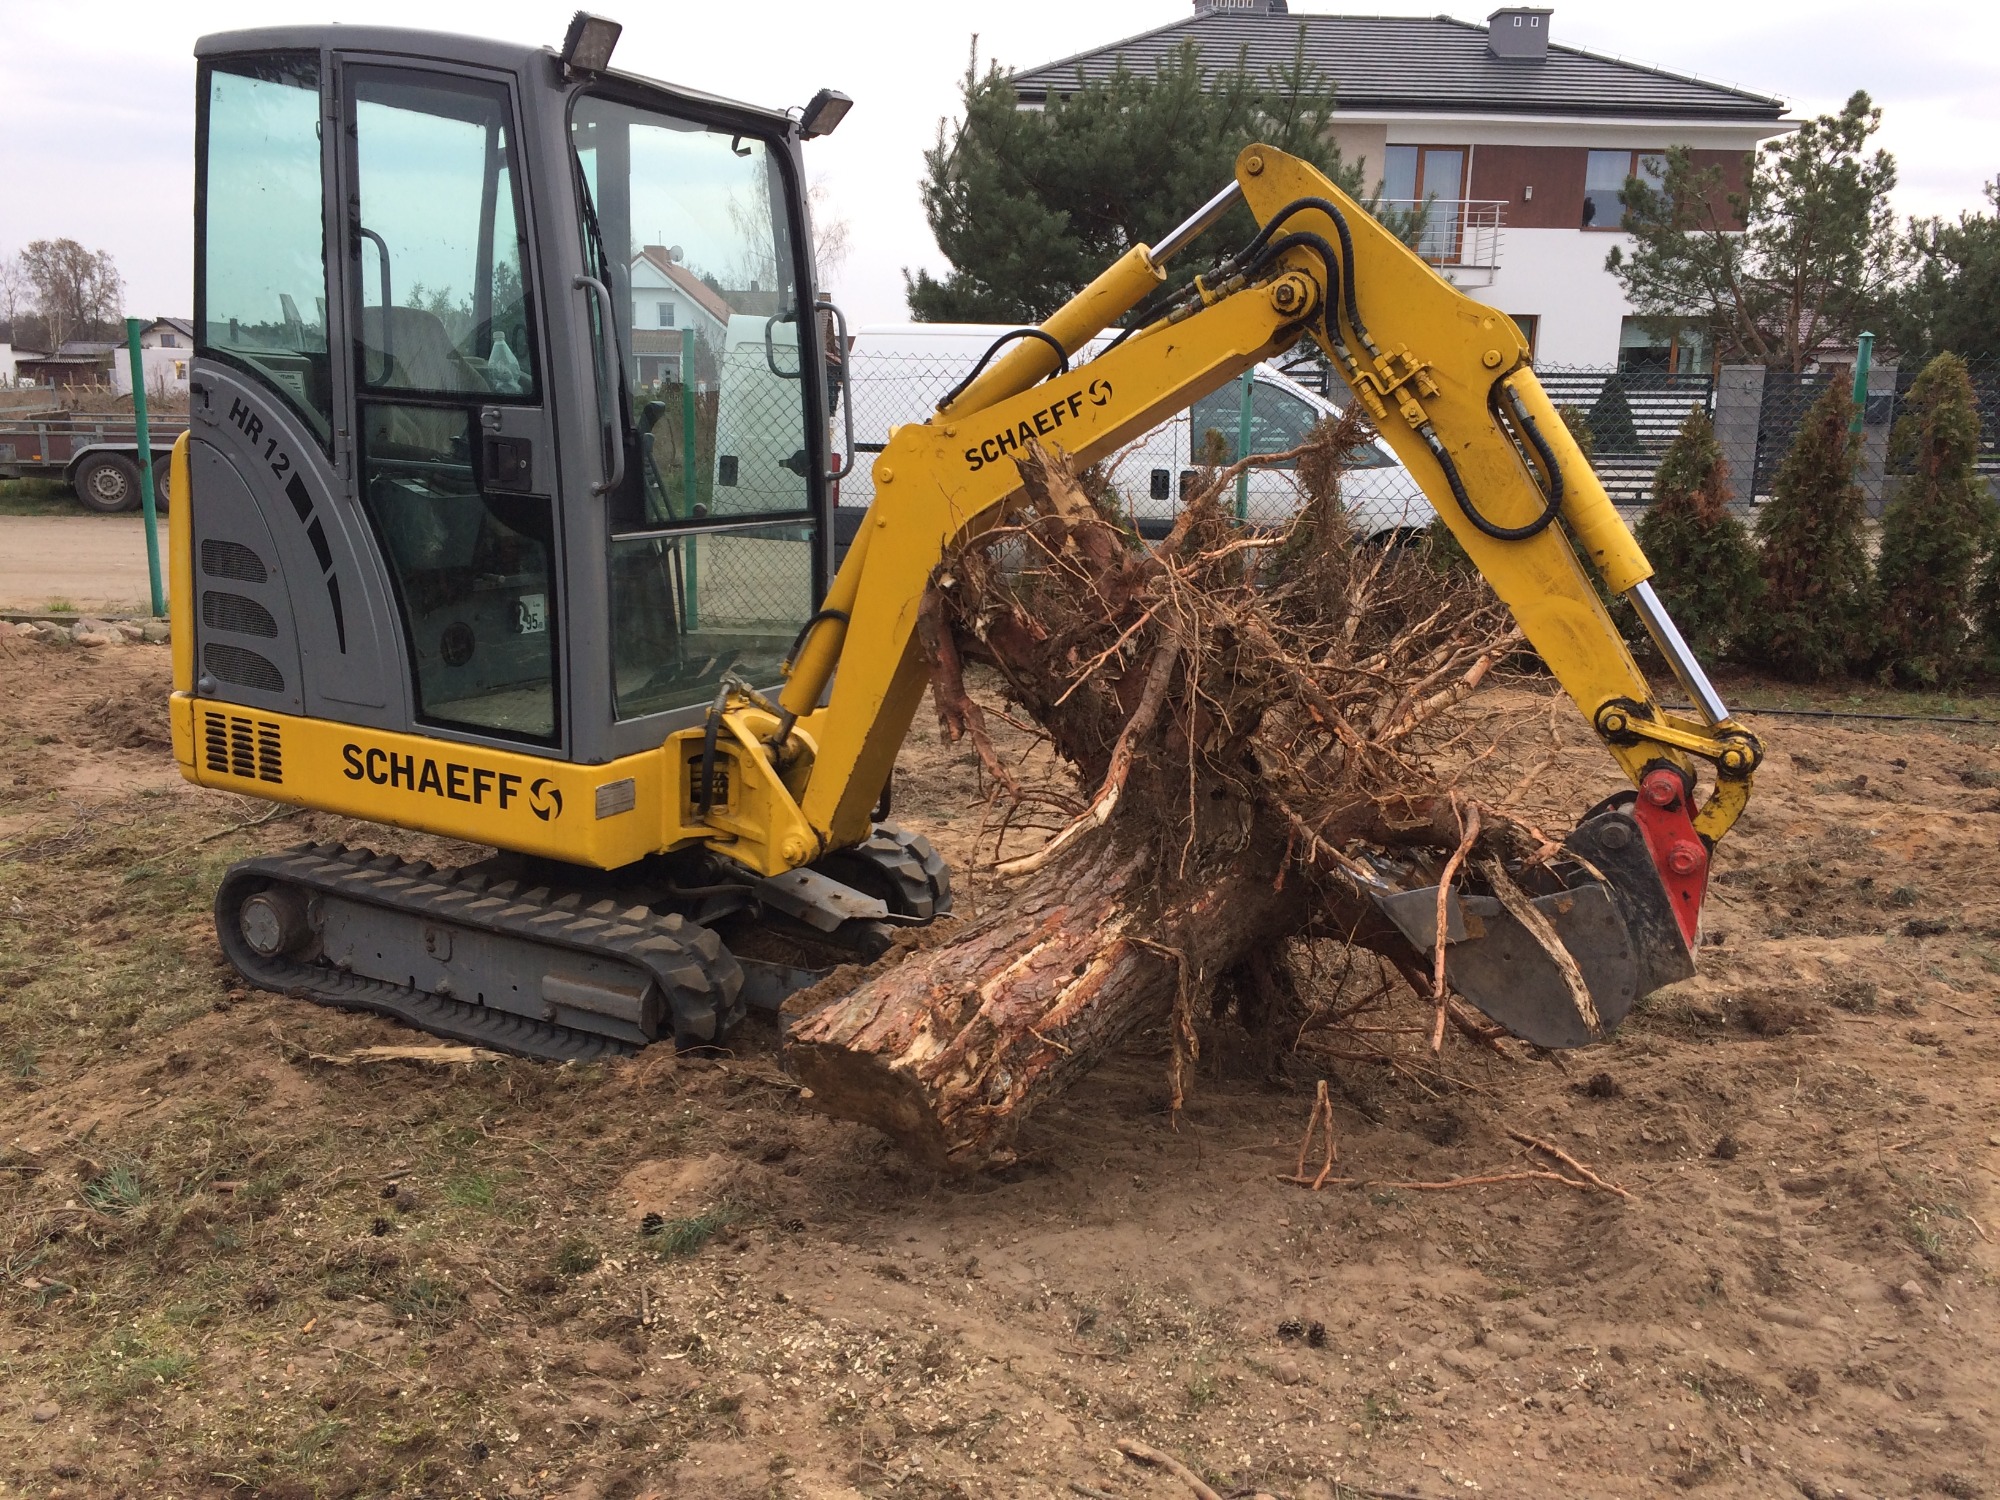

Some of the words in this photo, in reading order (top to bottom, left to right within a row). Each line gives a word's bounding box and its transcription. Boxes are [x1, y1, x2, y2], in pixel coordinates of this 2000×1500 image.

[229, 396, 263, 446] HR
[264, 438, 290, 480] 12
[965, 390, 1083, 472] SCHAEFF
[342, 743, 522, 810] SCHAEFF
